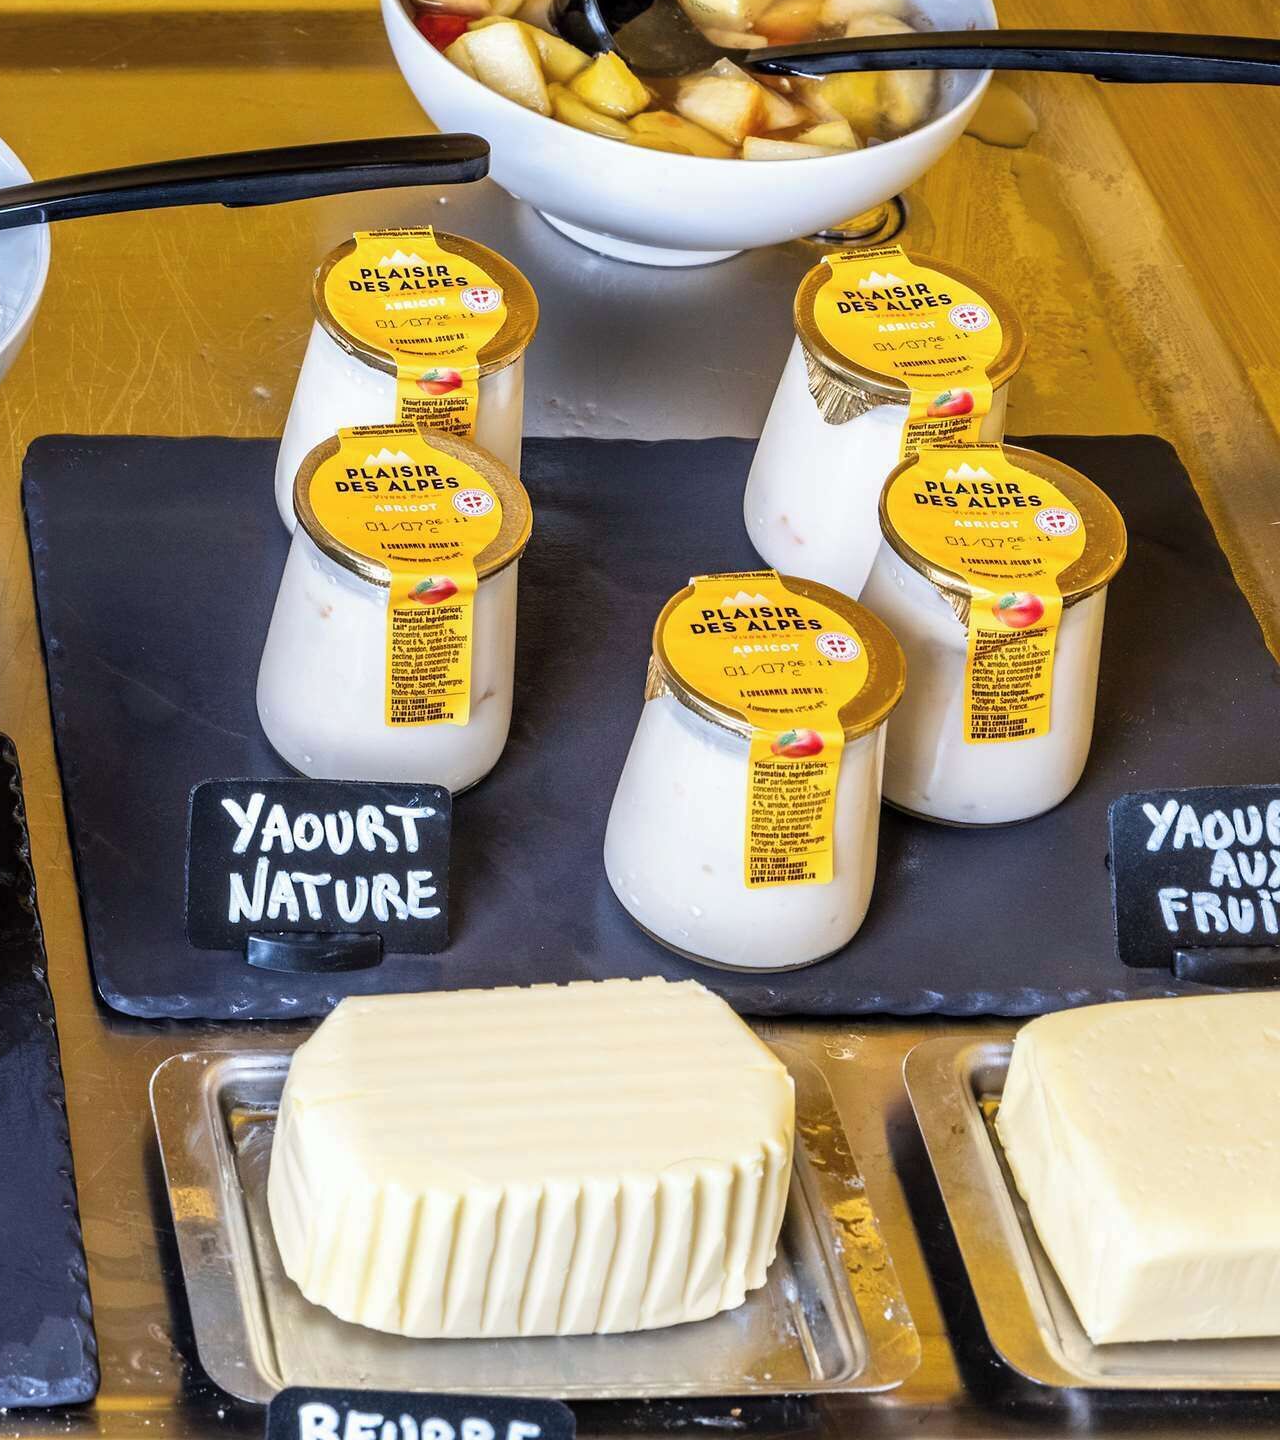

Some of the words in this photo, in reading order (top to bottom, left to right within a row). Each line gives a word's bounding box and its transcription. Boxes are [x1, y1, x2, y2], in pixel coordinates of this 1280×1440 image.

[360, 266, 450, 279] PLAISIR
[349, 280, 390, 293] DES
[400, 277, 469, 290] ALPES
[843, 283, 930, 300] PLAISIR
[837, 301, 878, 313] DES
[887, 294, 952, 311] ALPES
[878, 320, 936, 333] ABRICOT
[346, 465, 440, 479] PLAISIR
[335, 481, 378, 492] DES
[388, 477, 460, 492] ALPES
[925, 481, 1021, 495] PLAISIR
[374, 503, 438, 513] ABRICOT
[914, 494, 958, 507] DES
[968, 496, 1042, 508] ALPES
[954, 519, 1019, 528] ABRICOT
[702, 607, 800, 621] PLAISIR
[691, 622, 736, 634] DES
[748, 619, 822, 631] ALPES
[733, 643, 799, 655] ABRICOT
[221, 793, 436, 855] YAOURT
[229, 856, 441, 923] NATURE
